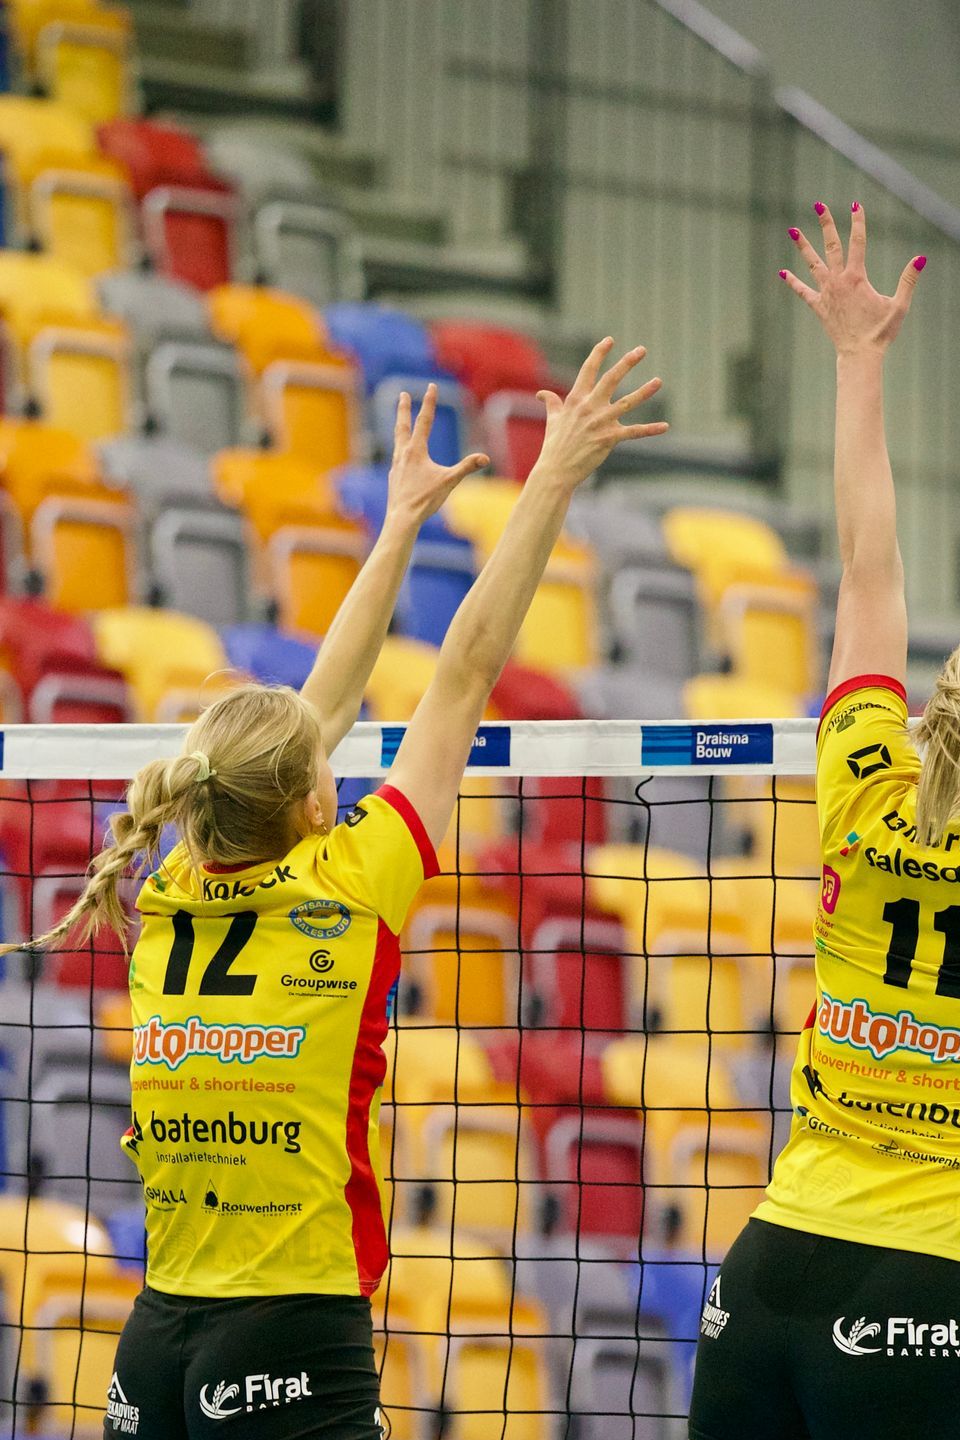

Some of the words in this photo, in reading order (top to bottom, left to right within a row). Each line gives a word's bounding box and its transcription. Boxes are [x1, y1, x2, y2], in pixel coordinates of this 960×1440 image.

[696, 732, 749, 746] Draisma
[695, 745, 732, 759] Bouw
[294, 917, 323, 937] SALES
[326, 918, 350, 937] CLUB
[163, 909, 258, 995] 12
[281, 975, 357, 991] Groupwise
[134, 1021, 300, 1065] utohopper
[897, 1070, 907, 1083] &
[189, 1077, 200, 1090] &
[204, 1078, 296, 1093] shortlease
[151, 1111, 302, 1154] batenburg
[156, 1152, 247, 1165] installatietechniek
[222, 1202, 302, 1213] Rouwenhorst
[887, 1318, 960, 1346] Firat
[245, 1371, 312, 1403] Firat
